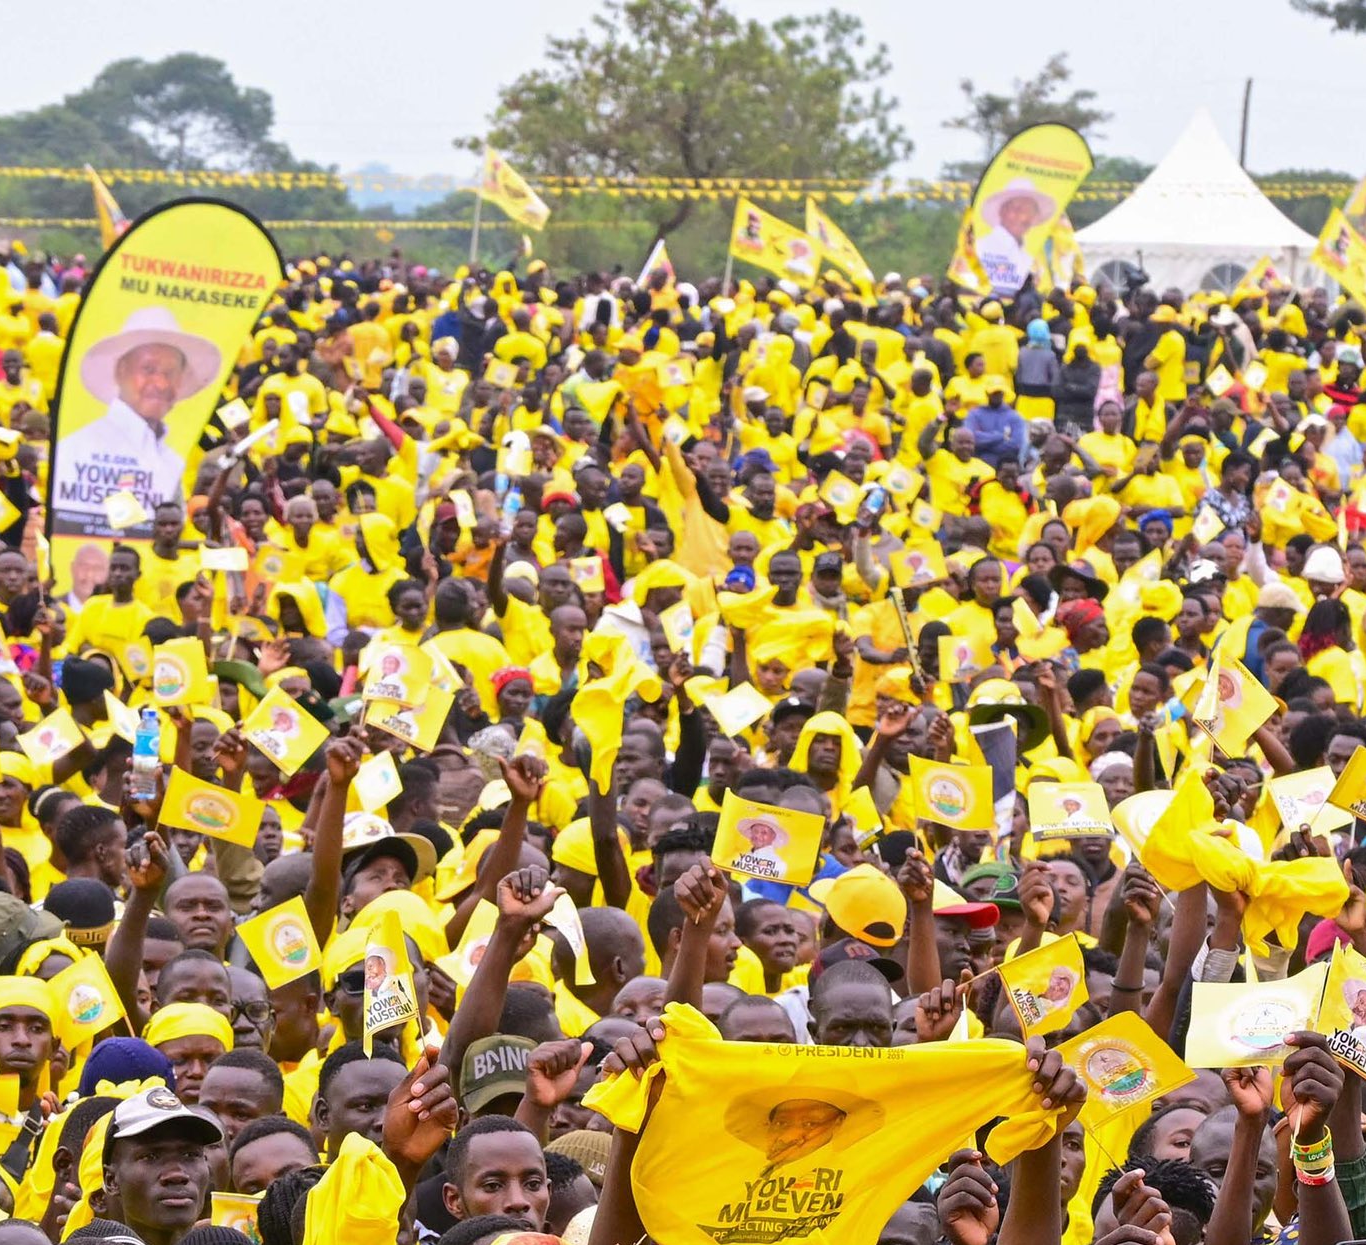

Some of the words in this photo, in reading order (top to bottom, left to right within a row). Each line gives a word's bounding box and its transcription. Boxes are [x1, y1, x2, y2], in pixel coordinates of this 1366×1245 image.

[120, 254, 266, 290] TUKWANIRIZZA
[121, 277, 149, 295] MU
[156, 282, 259, 308] NAKASEKE
[731, 859, 779, 879] MUSEVENI
[739, 853, 776, 869] YOWERI
[795, 1045, 882, 1059] PRESIDENT
[1308, 1152, 1325, 1161] LOVE
